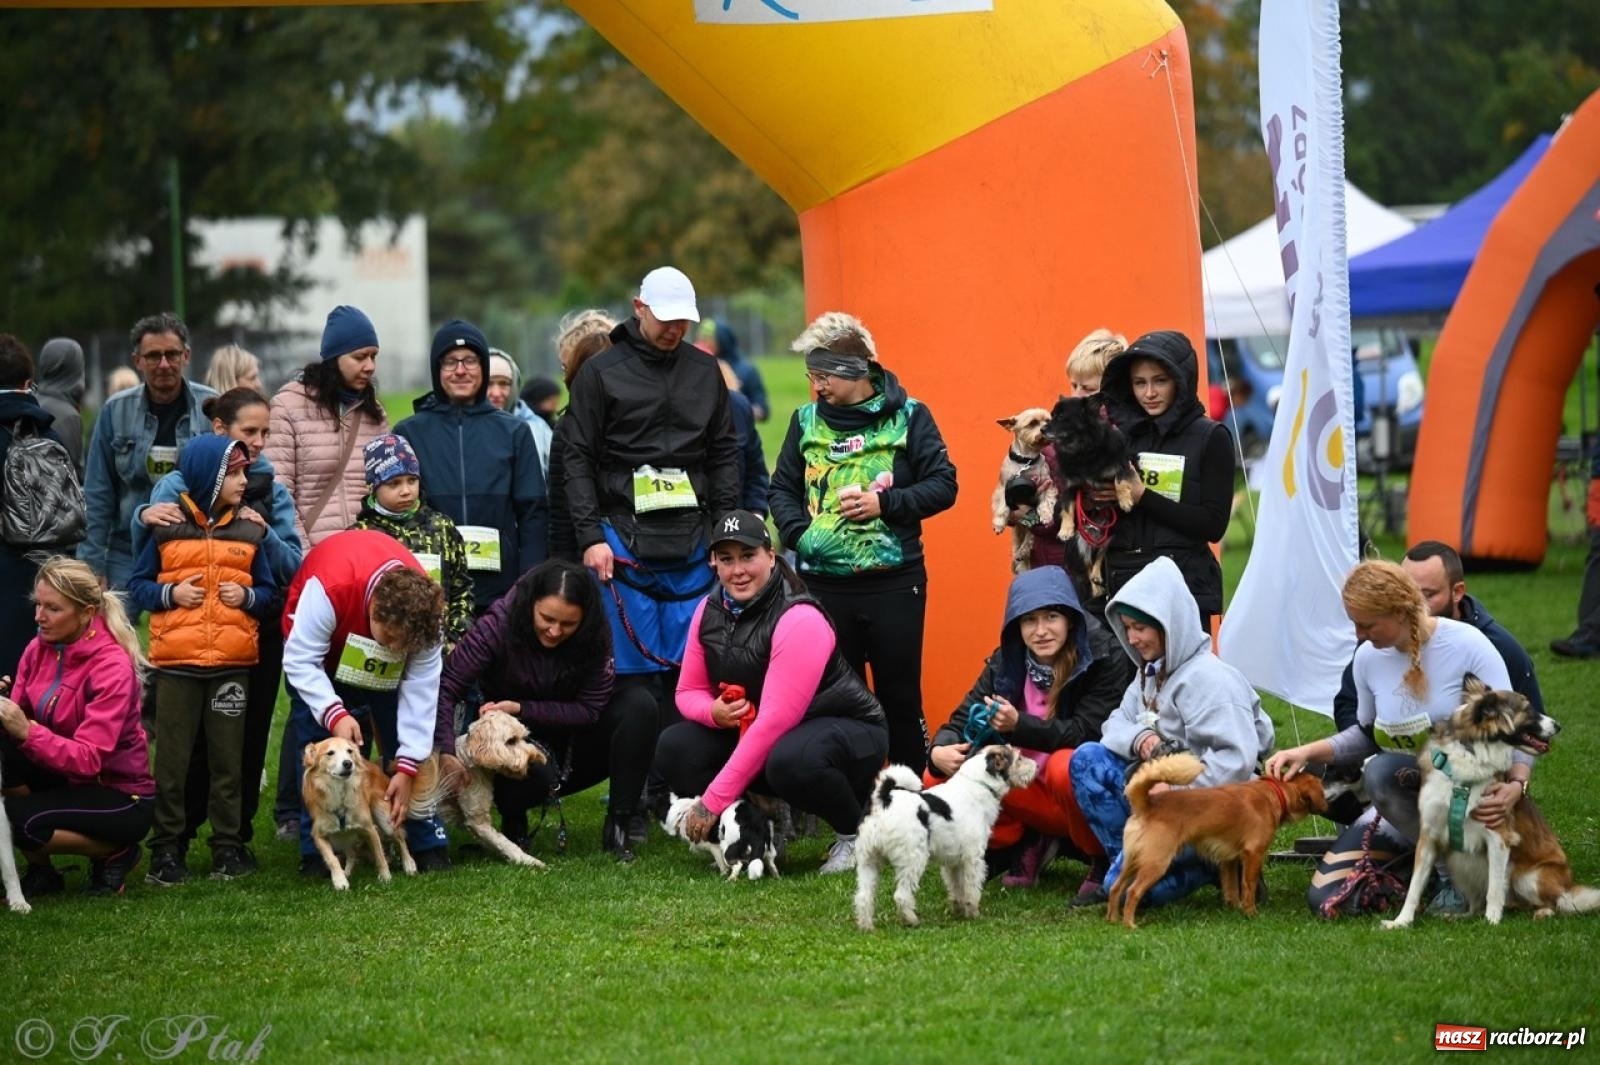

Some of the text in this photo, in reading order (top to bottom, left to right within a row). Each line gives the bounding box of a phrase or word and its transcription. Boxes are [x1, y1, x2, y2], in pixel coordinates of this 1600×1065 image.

[651, 478, 674, 492] 18
[724, 516, 740, 532] NY
[364, 657, 389, 676] 61
[1391, 734, 1416, 749] 13
